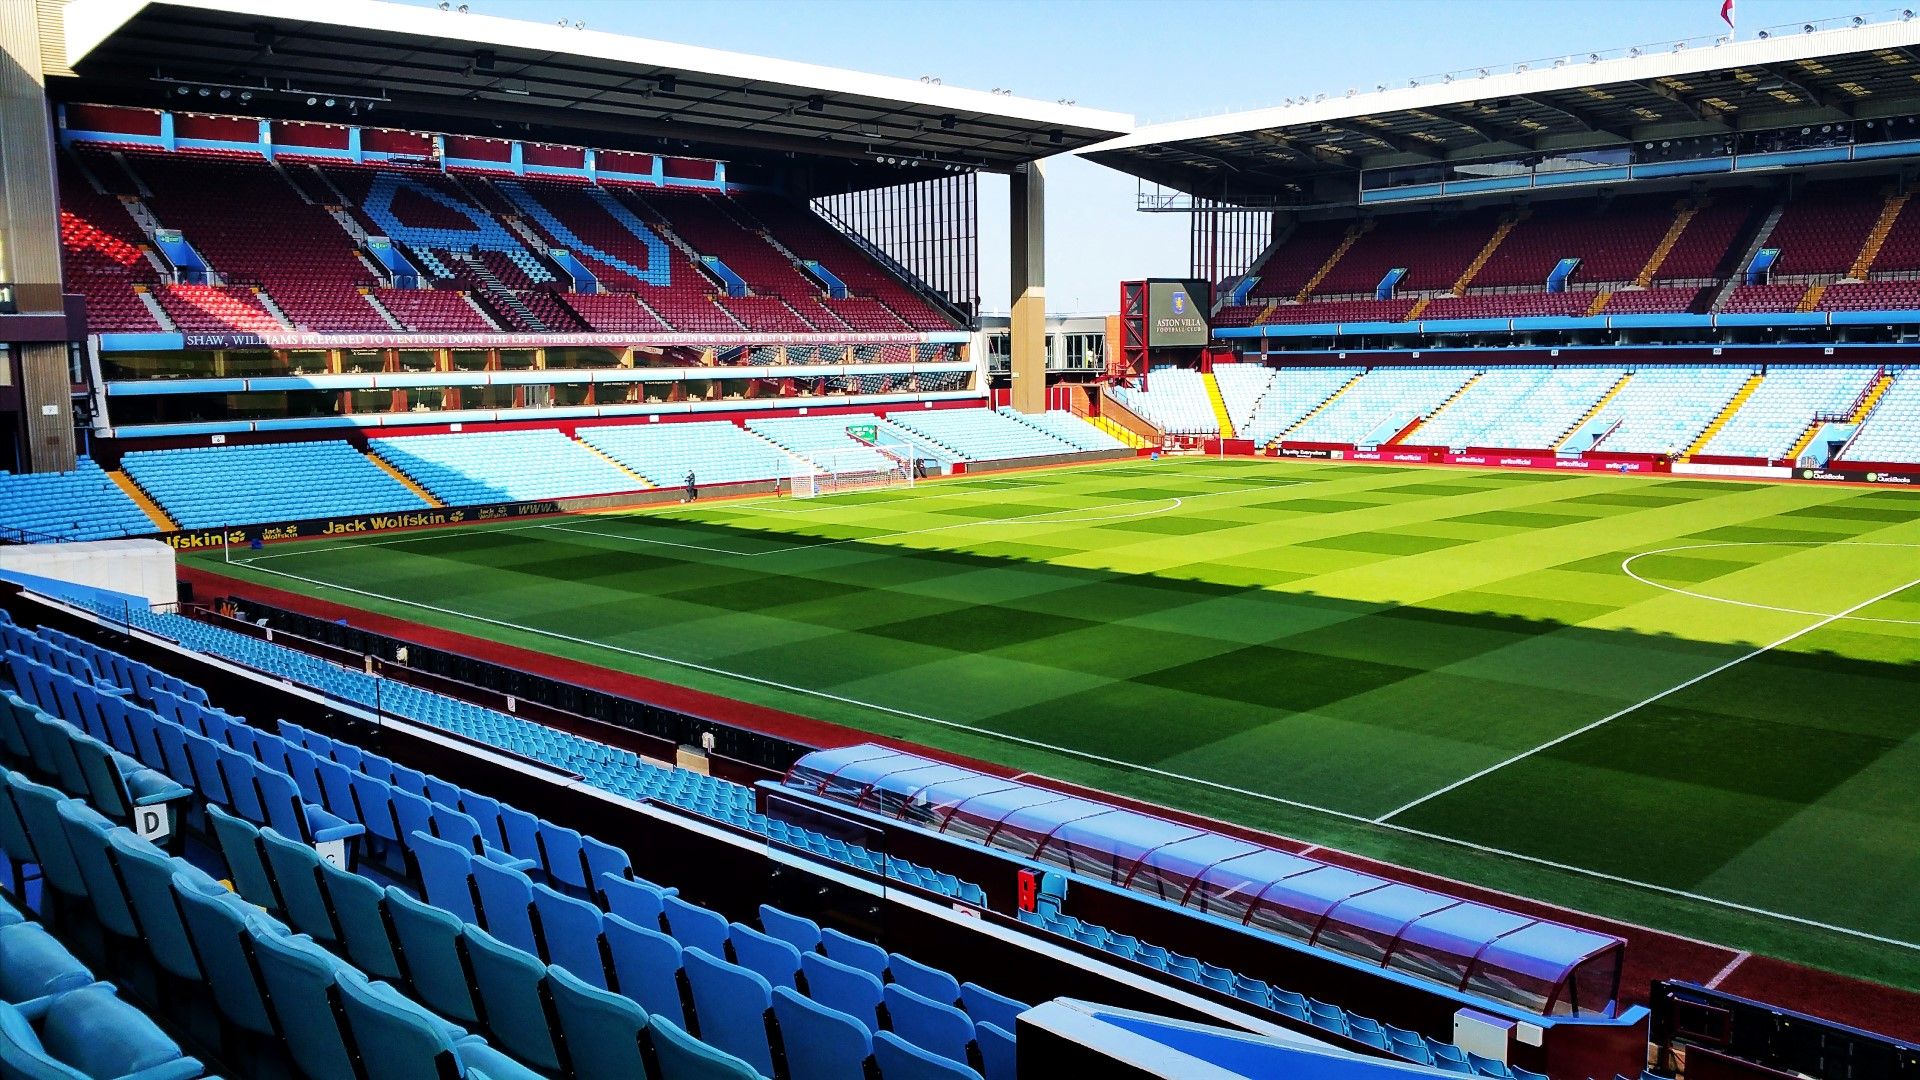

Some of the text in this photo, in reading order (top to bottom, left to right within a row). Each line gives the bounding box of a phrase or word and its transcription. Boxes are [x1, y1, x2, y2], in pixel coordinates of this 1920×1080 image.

[1157, 318, 1202, 327] ASTON VILLA
[187, 335, 228, 347] SHAW,
[232, 334, 298, 345] WILLIAMS
[301, 334, 365, 345] PREPARED
[367, 334, 385, 344] TO
[388, 334, 446, 344] VENTURE
[448, 334, 483, 344] DOWN
[487, 334, 508, 344] THE
[543, 334, 584, 344] THERE'S
[586, 335, 593, 343] A
[595, 334, 624, 343] GOOD
[626, 334, 649, 343] BALL
[652, 334, 687, 343] PLAYED
[700, 334, 717, 342] FOR
[720, 334, 741, 342] TONY
[806, 334, 826, 342] MUST
[322, 512, 446, 535] Jack Wolfskin
[261, 527, 282, 536] Jack
[262, 532, 298, 541] Wolfskin
[166, 532, 223, 550] lfskin
[143, 811, 160, 834] D
